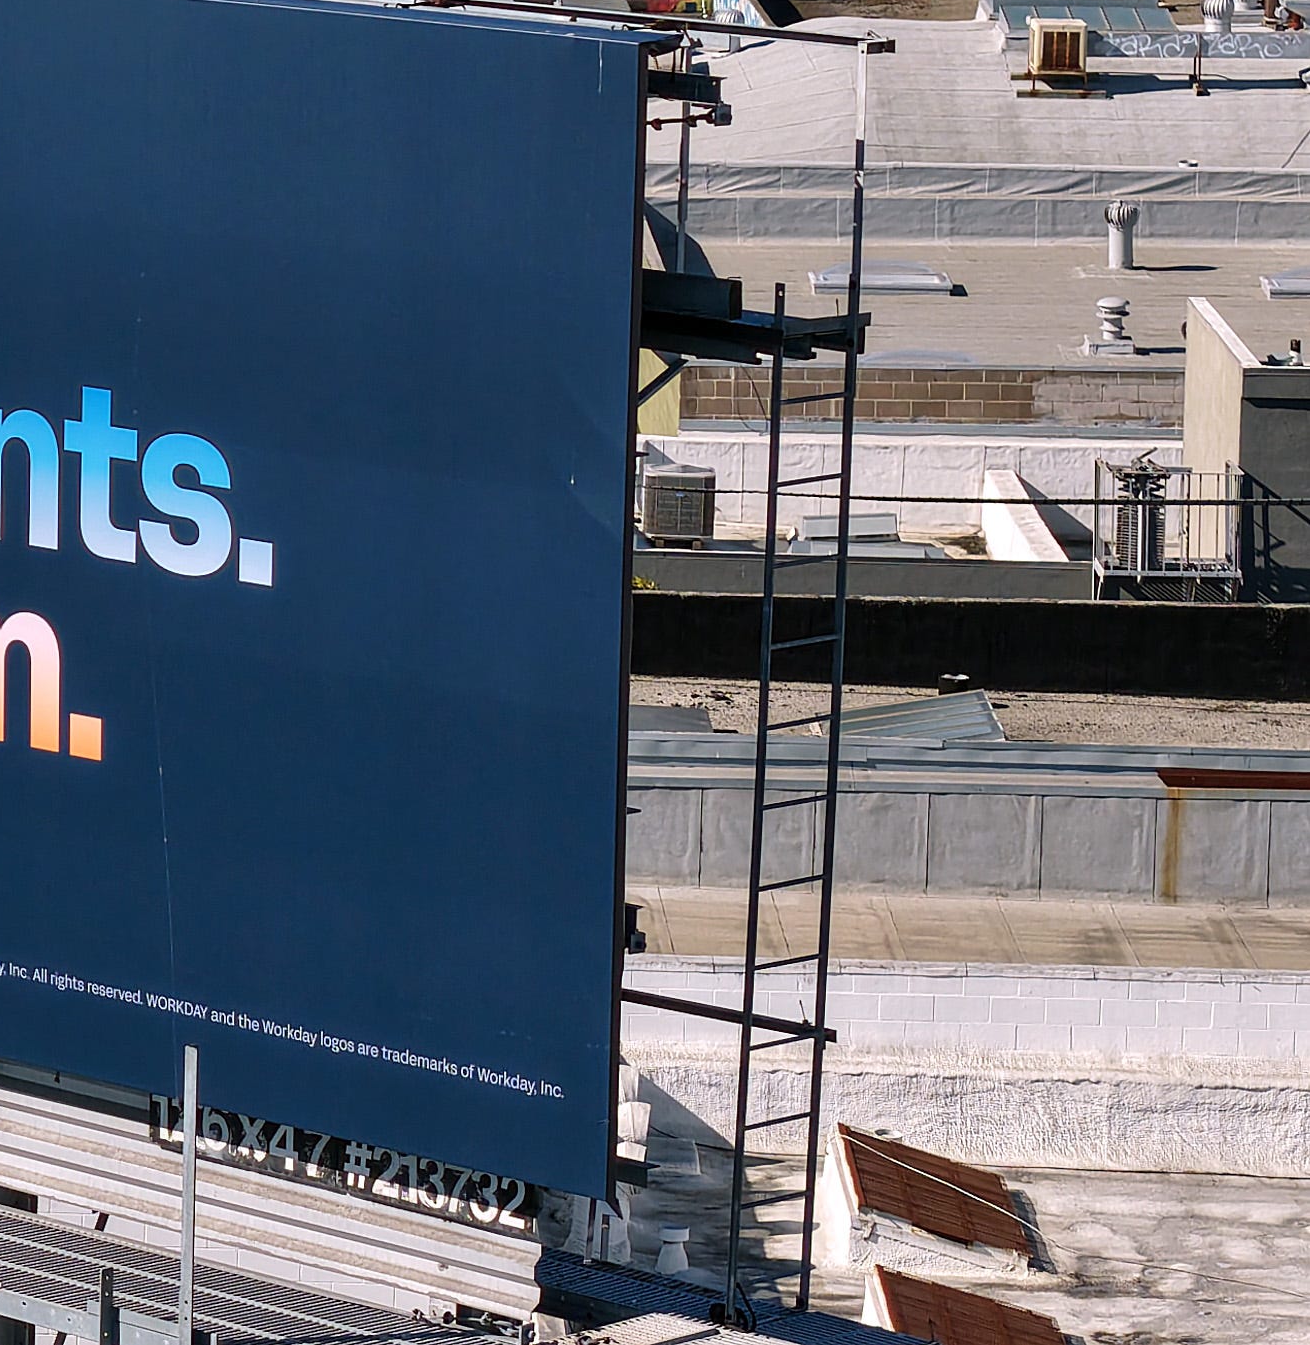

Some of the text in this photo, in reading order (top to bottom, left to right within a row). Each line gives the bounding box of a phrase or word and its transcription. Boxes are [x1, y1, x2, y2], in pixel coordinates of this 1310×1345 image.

[9, 962, 30, 981] Inc.
[32, 967, 48, 985] All
[50, 972, 85, 992] rights
[87, 981, 144, 1006] reserved.
[145, 992, 209, 1021] WORKDAY
[210, 1008, 235, 1028] and
[237, 1013, 261, 1032] the
[261, 1019, 318, 1048] Workday
[320, 1030, 355, 1054] logos
[357, 1041, 379, 1058] are
[381, 1045, 459, 1077] trademarks
[460, 1064, 475, 1079] of
[477, 1067, 538, 1097] Workday,
[540, 1080, 565, 1100] Inc.
[343, 1140, 526, 1230] #213732
